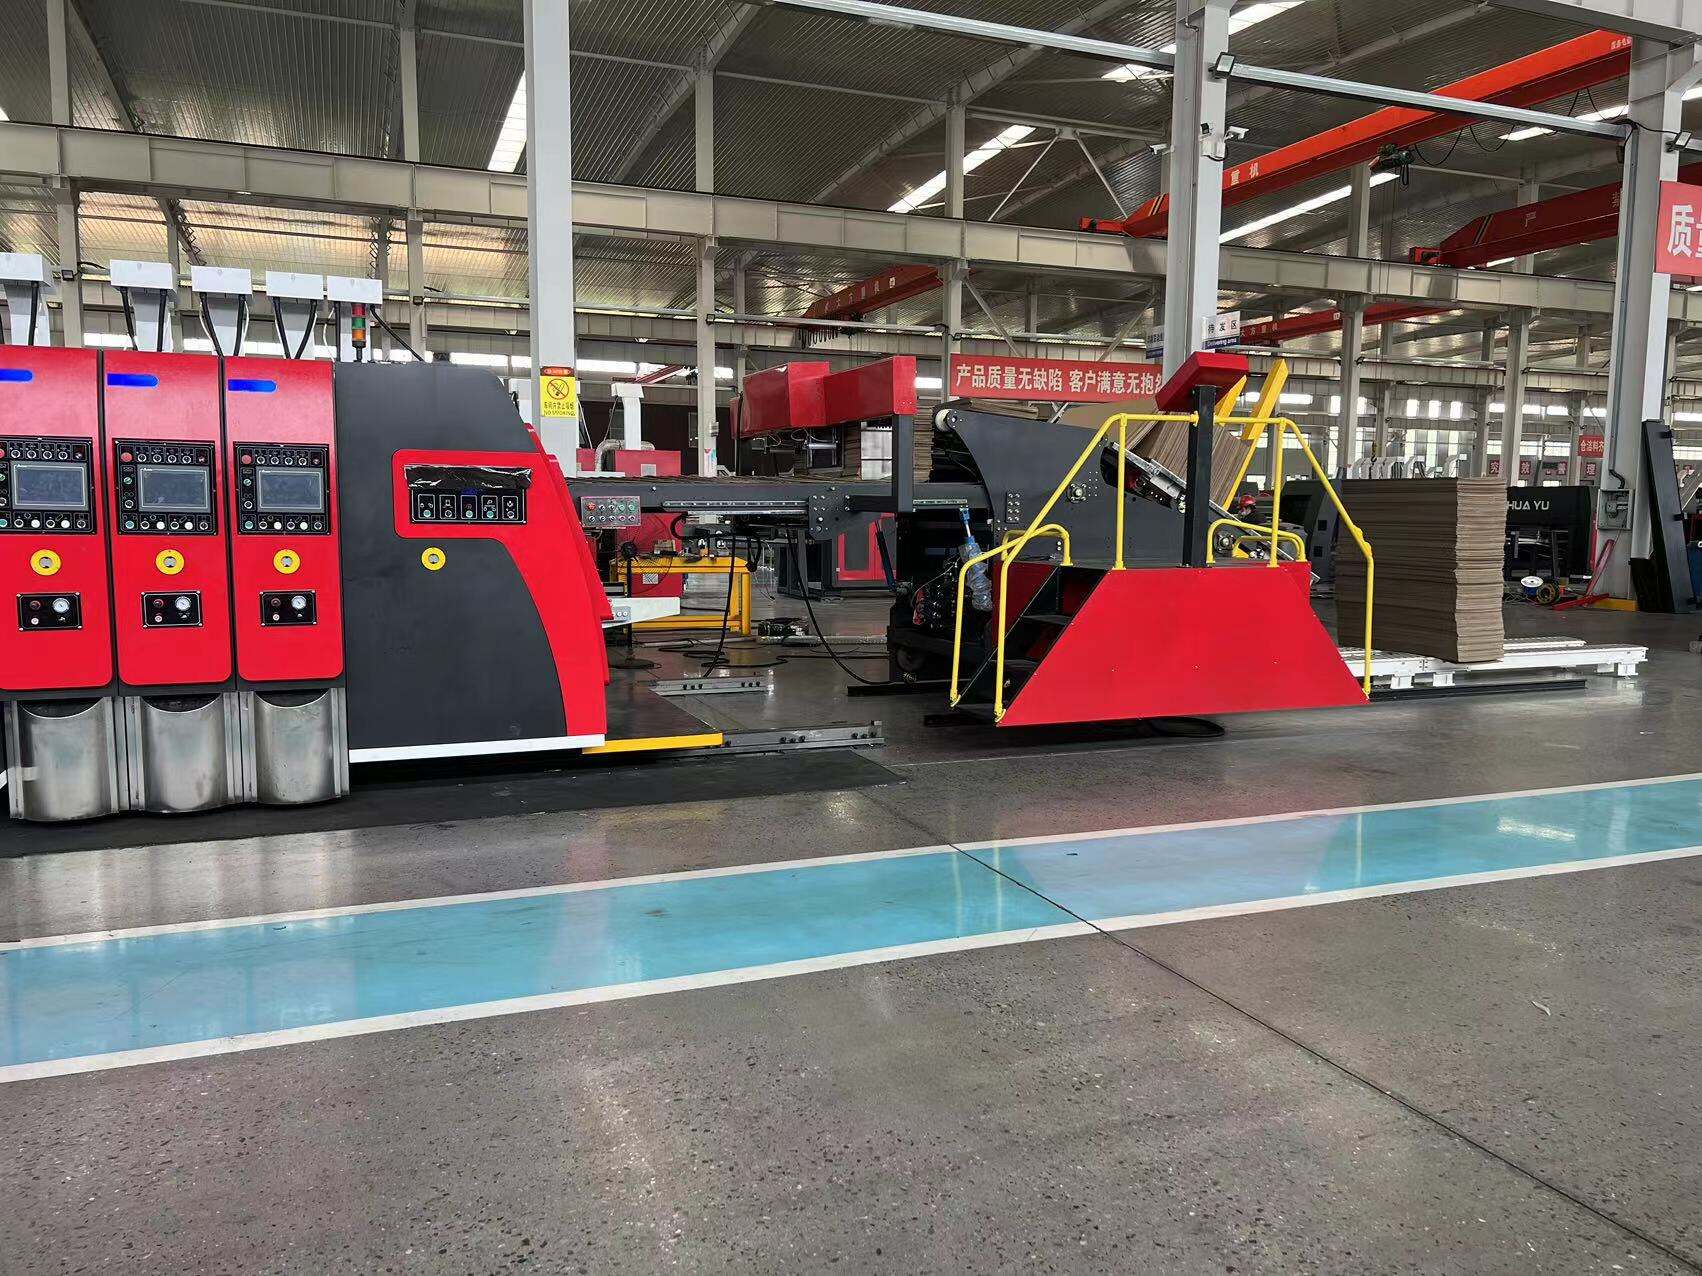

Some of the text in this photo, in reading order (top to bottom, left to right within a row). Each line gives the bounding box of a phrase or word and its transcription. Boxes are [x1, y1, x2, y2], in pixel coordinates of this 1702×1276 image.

[1230, 162, 1259, 186] 重机
[1667, 204, 1702, 258] 质
[1208, 320, 1236, 333] 待发区
[956, 363, 1063, 392] 产品质量无缺陷
[1533, 501, 1550, 510] YU
